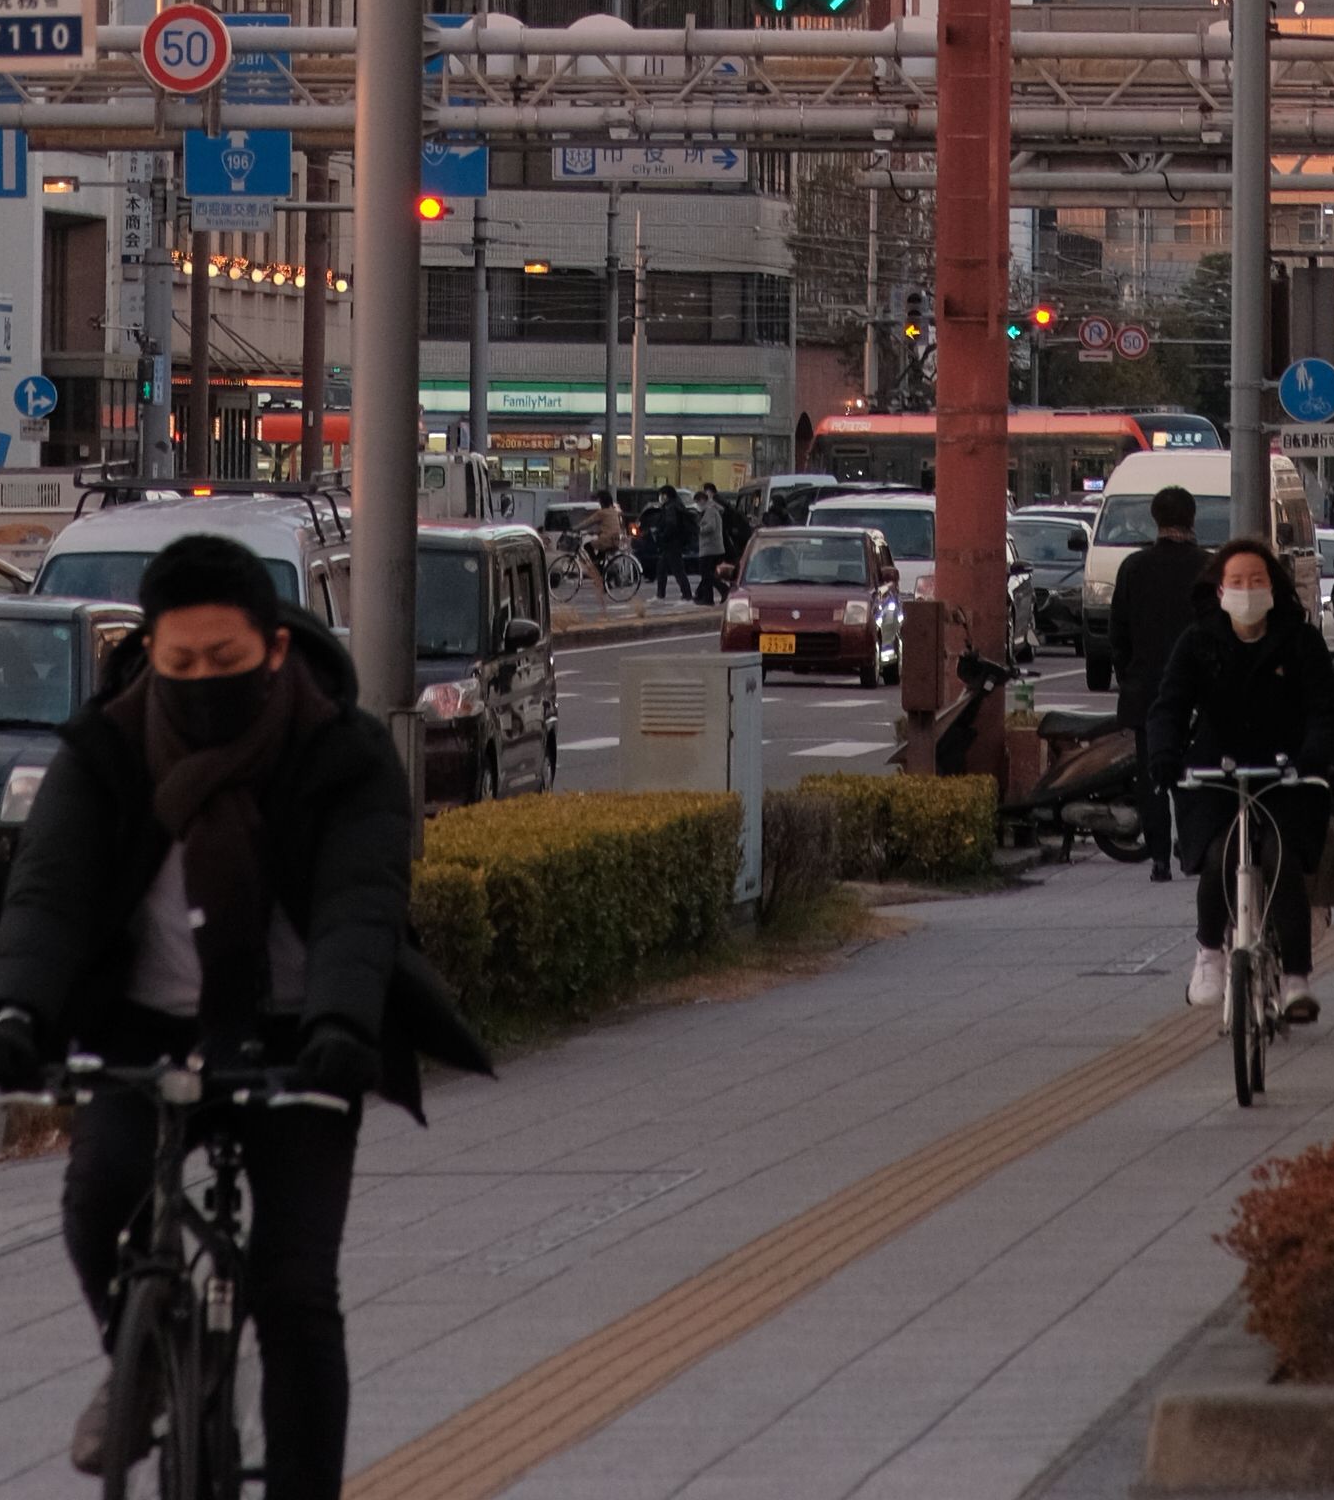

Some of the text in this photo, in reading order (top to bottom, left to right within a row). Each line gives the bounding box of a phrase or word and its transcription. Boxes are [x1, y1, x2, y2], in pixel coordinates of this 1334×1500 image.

[163, 30, 207, 67] 50
[227, 154, 249, 170] 196
[632, 164, 675, 176] City Hall
[1123, 334, 1142, 350] 50
[503, 394, 562, 409] FamilyMart
